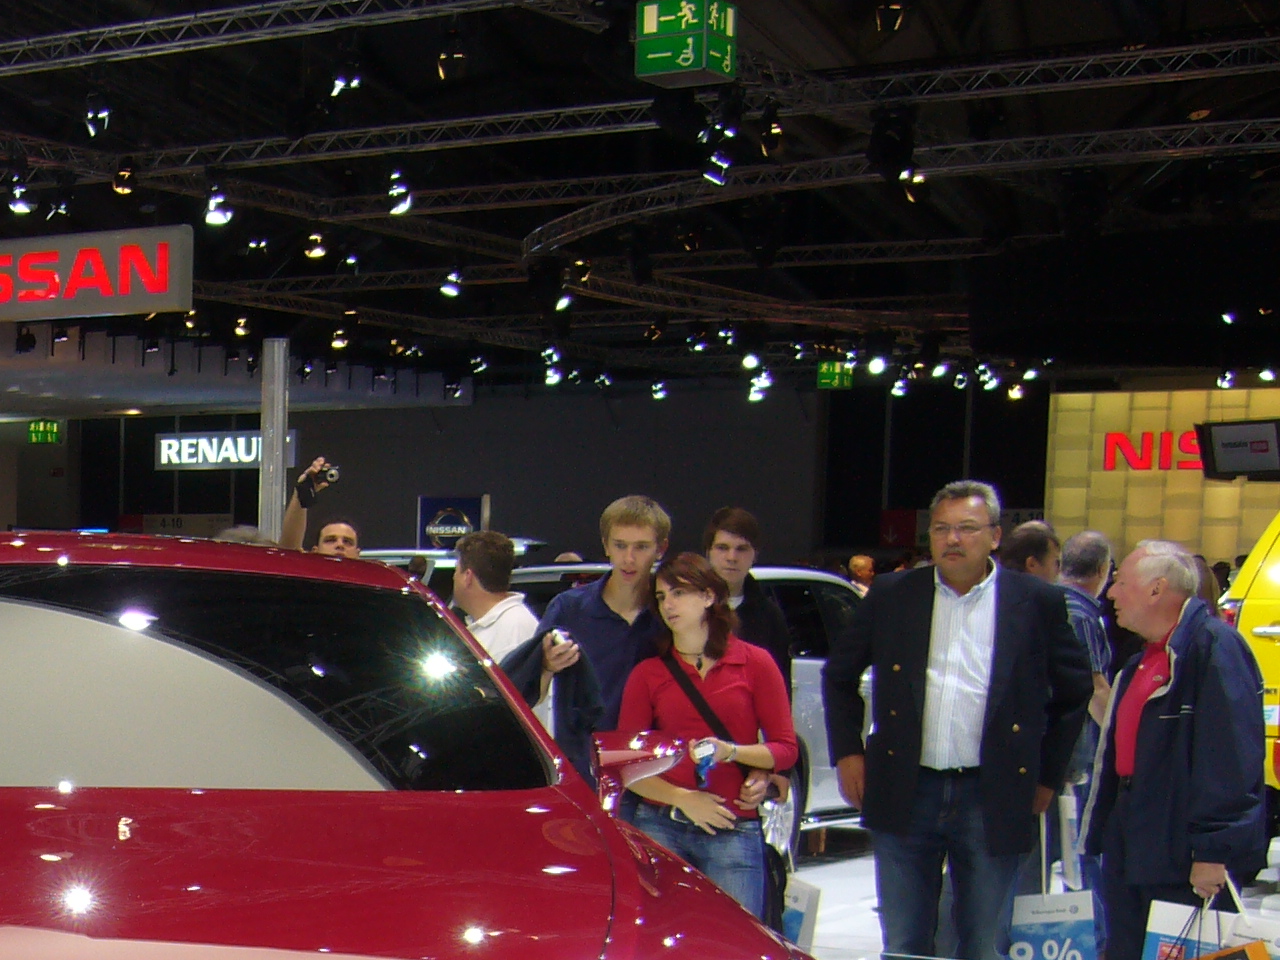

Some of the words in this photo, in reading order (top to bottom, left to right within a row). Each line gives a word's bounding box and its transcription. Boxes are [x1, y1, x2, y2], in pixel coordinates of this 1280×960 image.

[160, 436, 291, 464] RENAU
[1104, 431, 1204, 470] NIS
[428, 526, 467, 534] NISSAN
